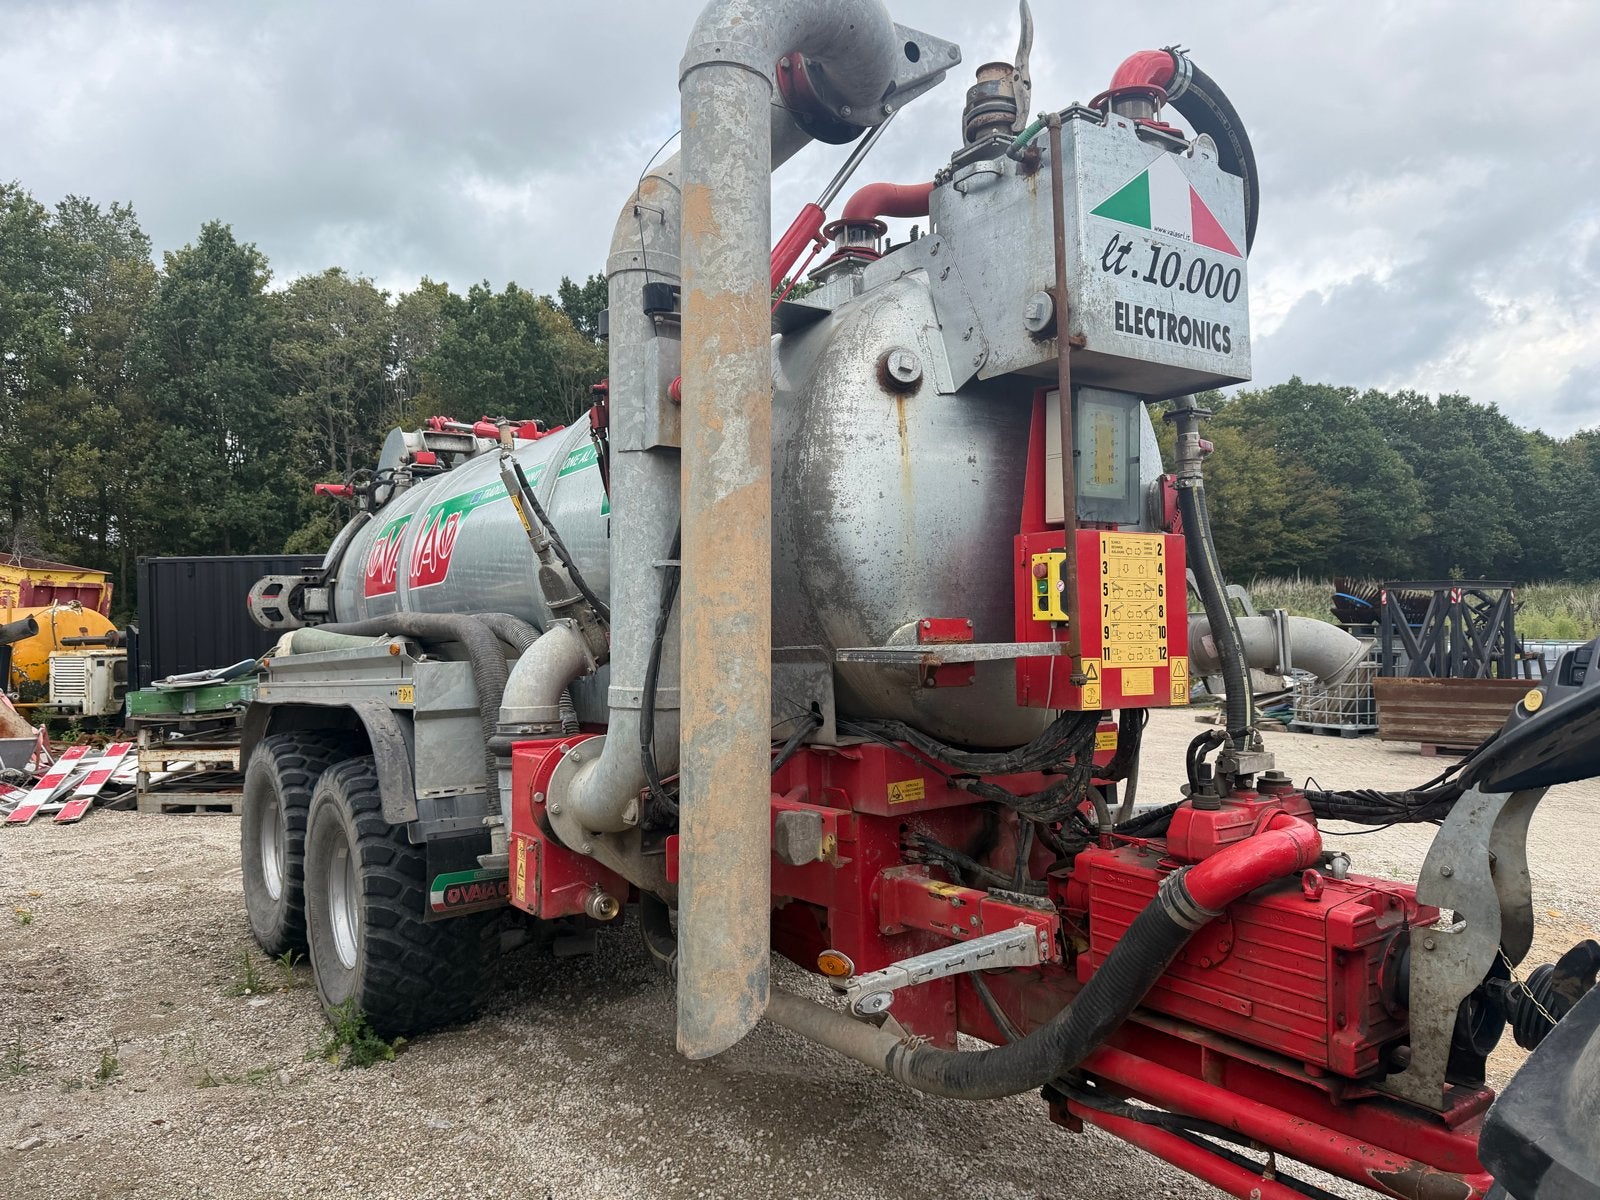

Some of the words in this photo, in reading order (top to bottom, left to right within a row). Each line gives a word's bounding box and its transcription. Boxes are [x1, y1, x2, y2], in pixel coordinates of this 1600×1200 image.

[1153, 225, 1191, 242] www.vaiasrl.it
[1114, 300, 1232, 354] ELECTRONICS
[1102, 540, 1106, 554] 1
[1157, 543, 1163, 556] 2
[1102, 561, 1108, 575] 3
[1157, 562, 1163, 576] 4
[1103, 583, 1109, 597] 5
[1158, 583, 1164, 597] 6
[1104, 604, 1109, 618] 7
[1158, 605, 1164, 618] 8
[1104, 626, 1110, 640] 9
[1158, 626, 1166, 639] 10
[1103, 647, 1110, 661] 11
[1158, 647, 1167, 660] 12
